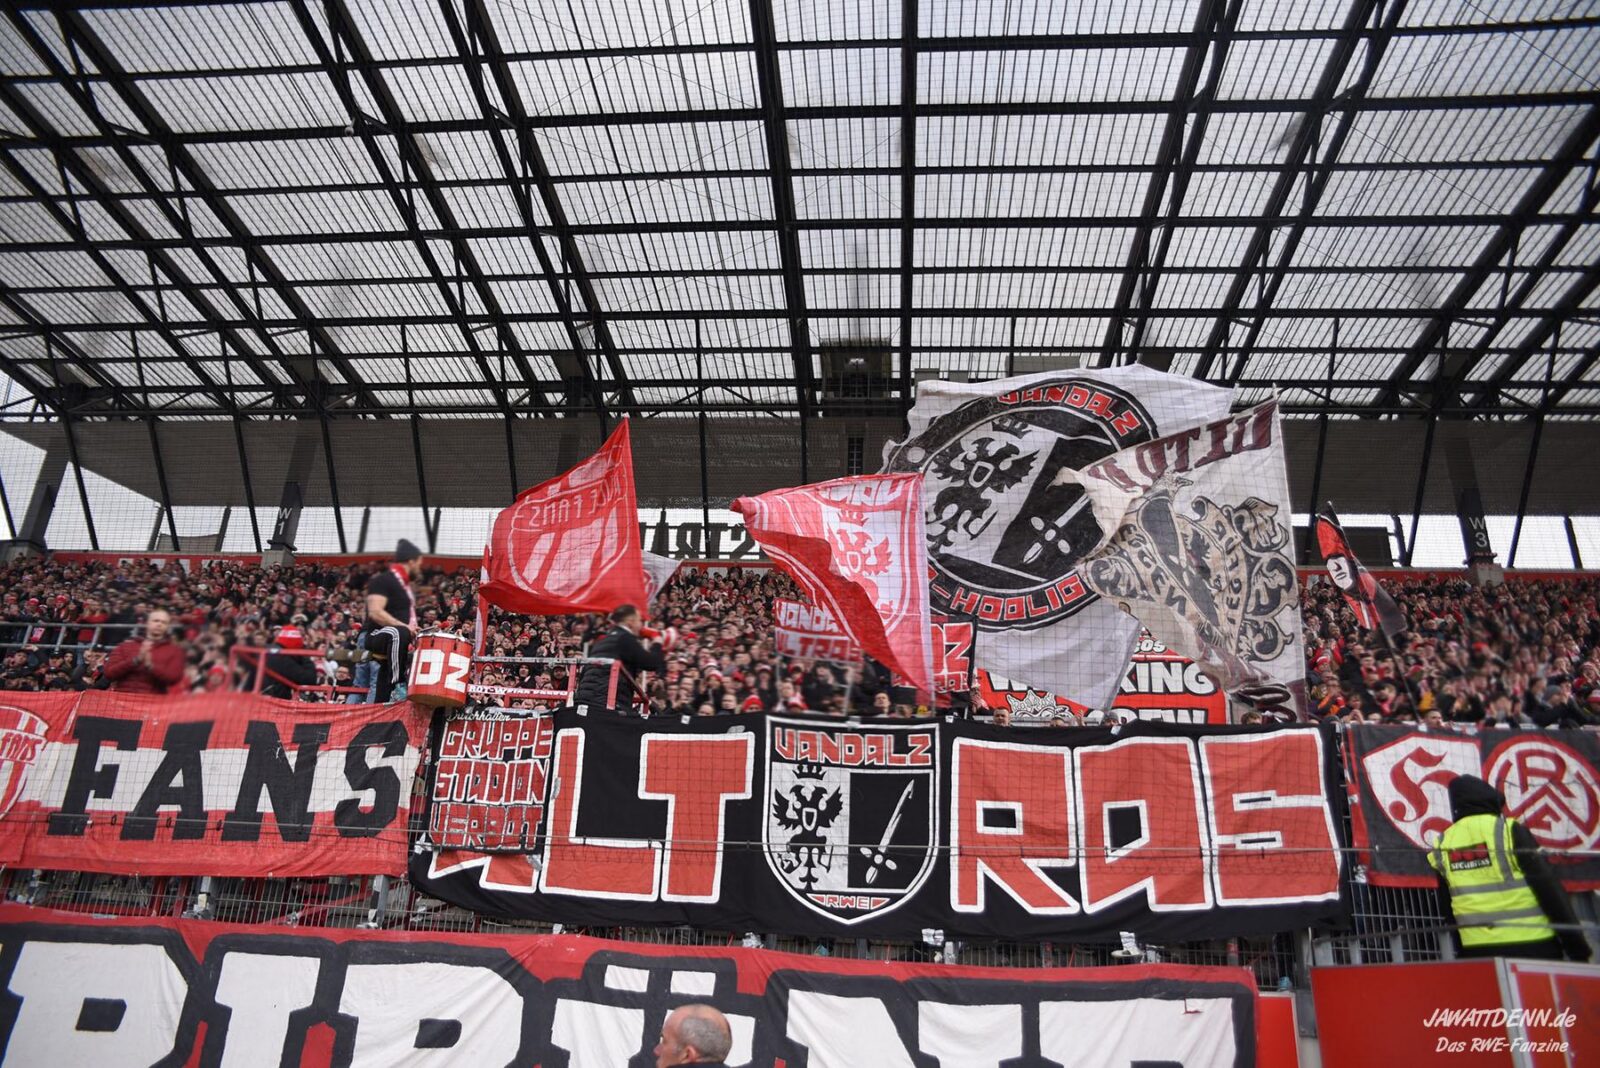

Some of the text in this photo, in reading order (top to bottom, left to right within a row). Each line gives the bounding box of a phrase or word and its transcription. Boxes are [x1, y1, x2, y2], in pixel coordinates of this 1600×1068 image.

[279, 507, 292, 519] W
[1469, 516, 1485, 530] W
[278, 521, 284, 535] 1
[1475, 531, 1487, 548] 3
[440, 715, 554, 760] GRUPPE
[774, 726, 933, 766] VANDALZ
[46, 715, 410, 842] FANS
[433, 758, 550, 804] STADION
[429, 802, 546, 849] VERBOT
[824, 894, 871, 909] RWE
